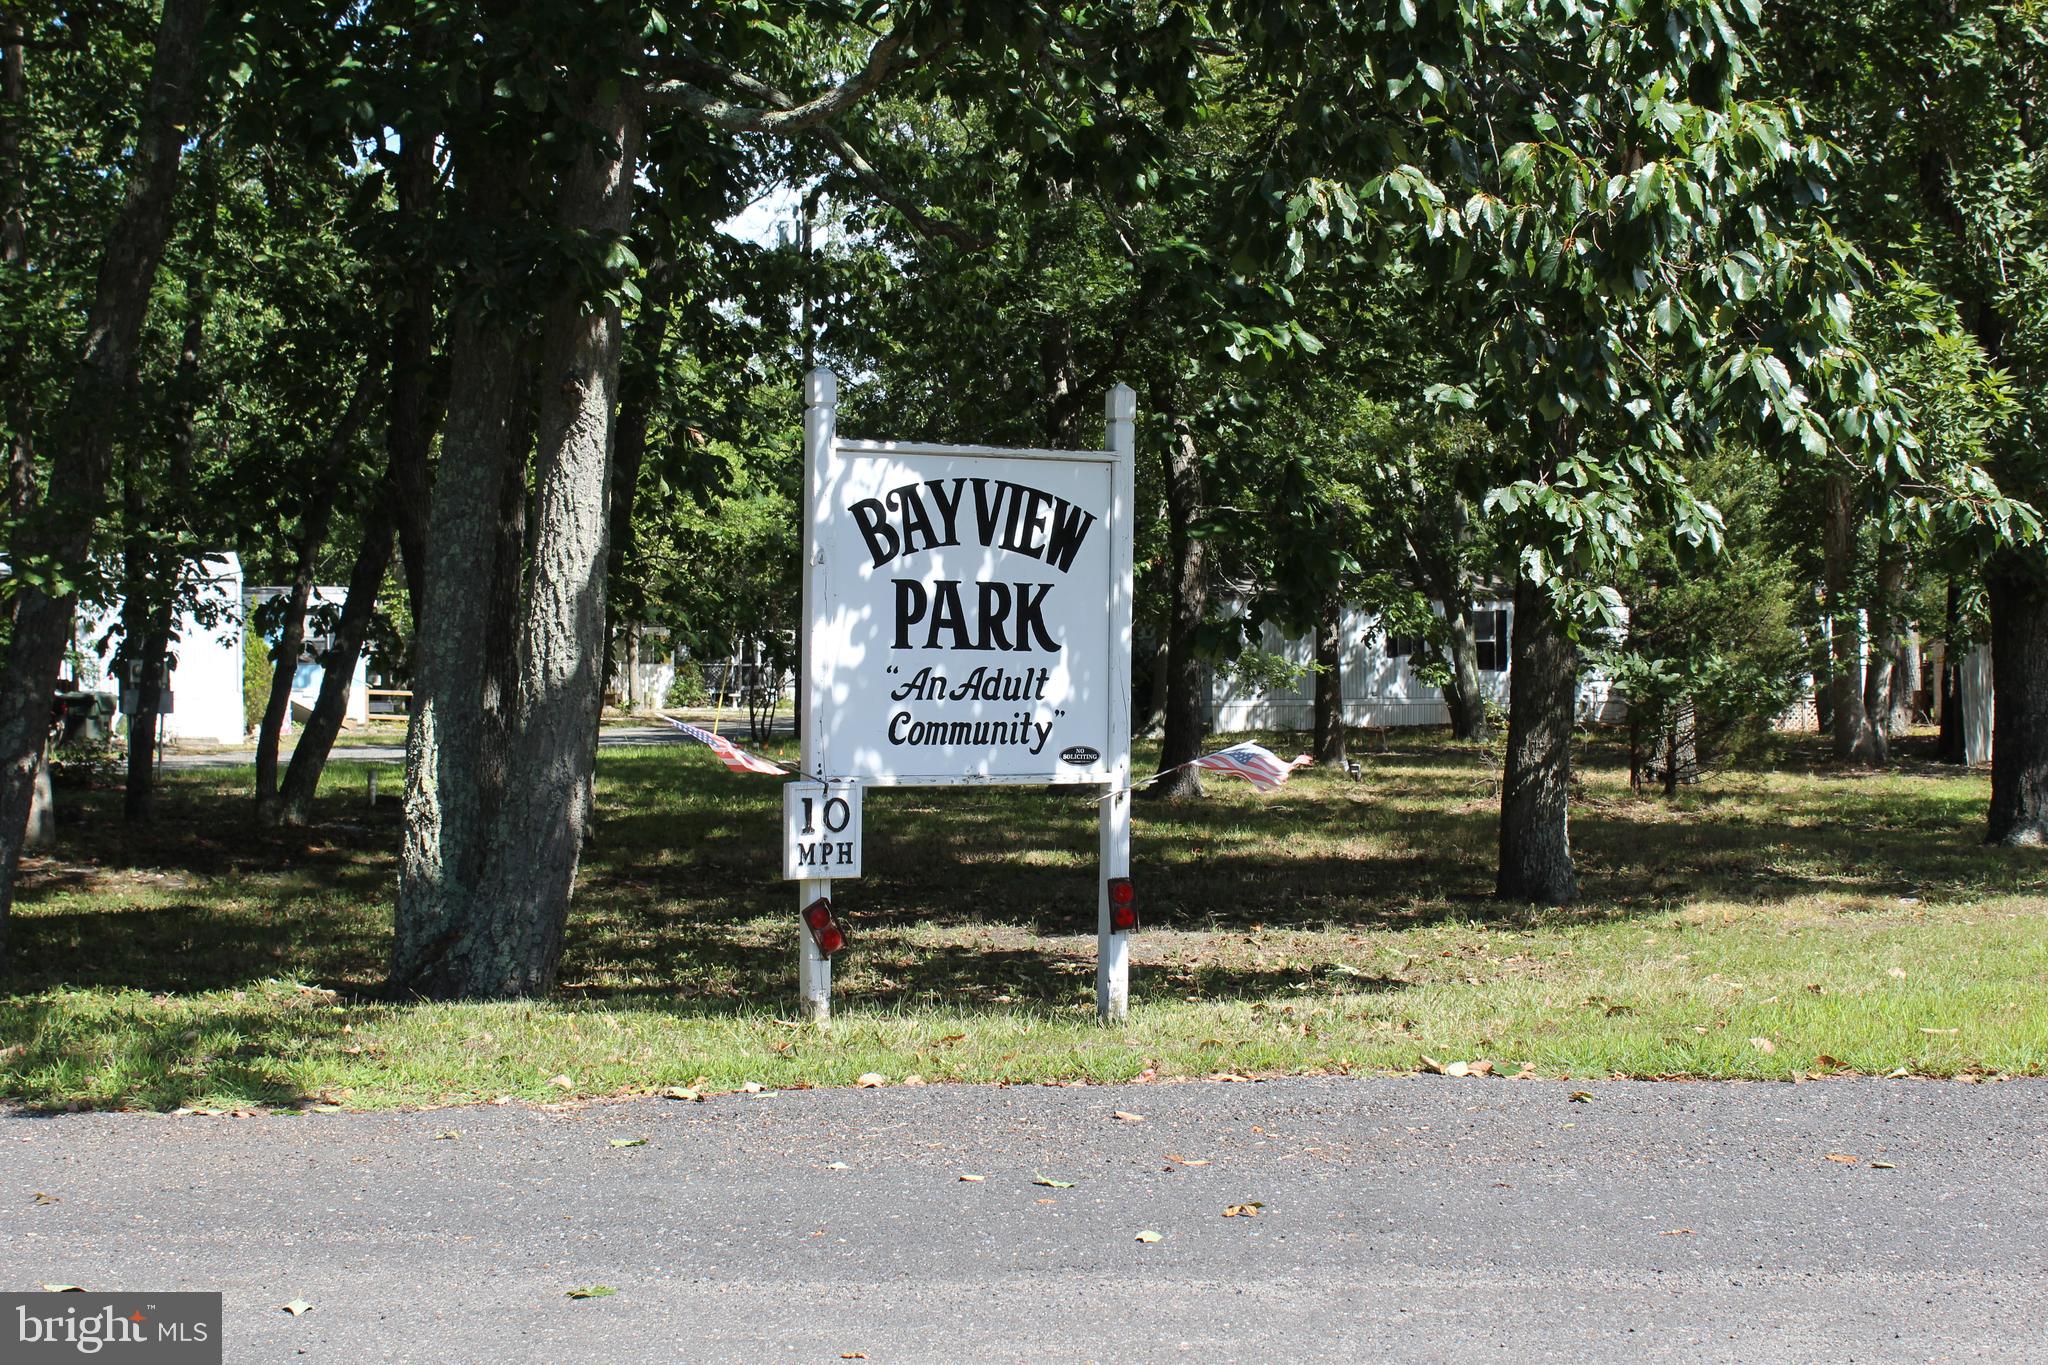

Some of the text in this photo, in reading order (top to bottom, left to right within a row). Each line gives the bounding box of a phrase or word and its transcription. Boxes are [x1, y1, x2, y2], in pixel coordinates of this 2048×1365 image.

[847, 477, 1097, 574] BAYVIEW
[890, 578, 1062, 653] PARK
[949, 666, 1050, 701] Adult
[801, 797, 850, 835] 10
[798, 842, 854, 866] MPH
